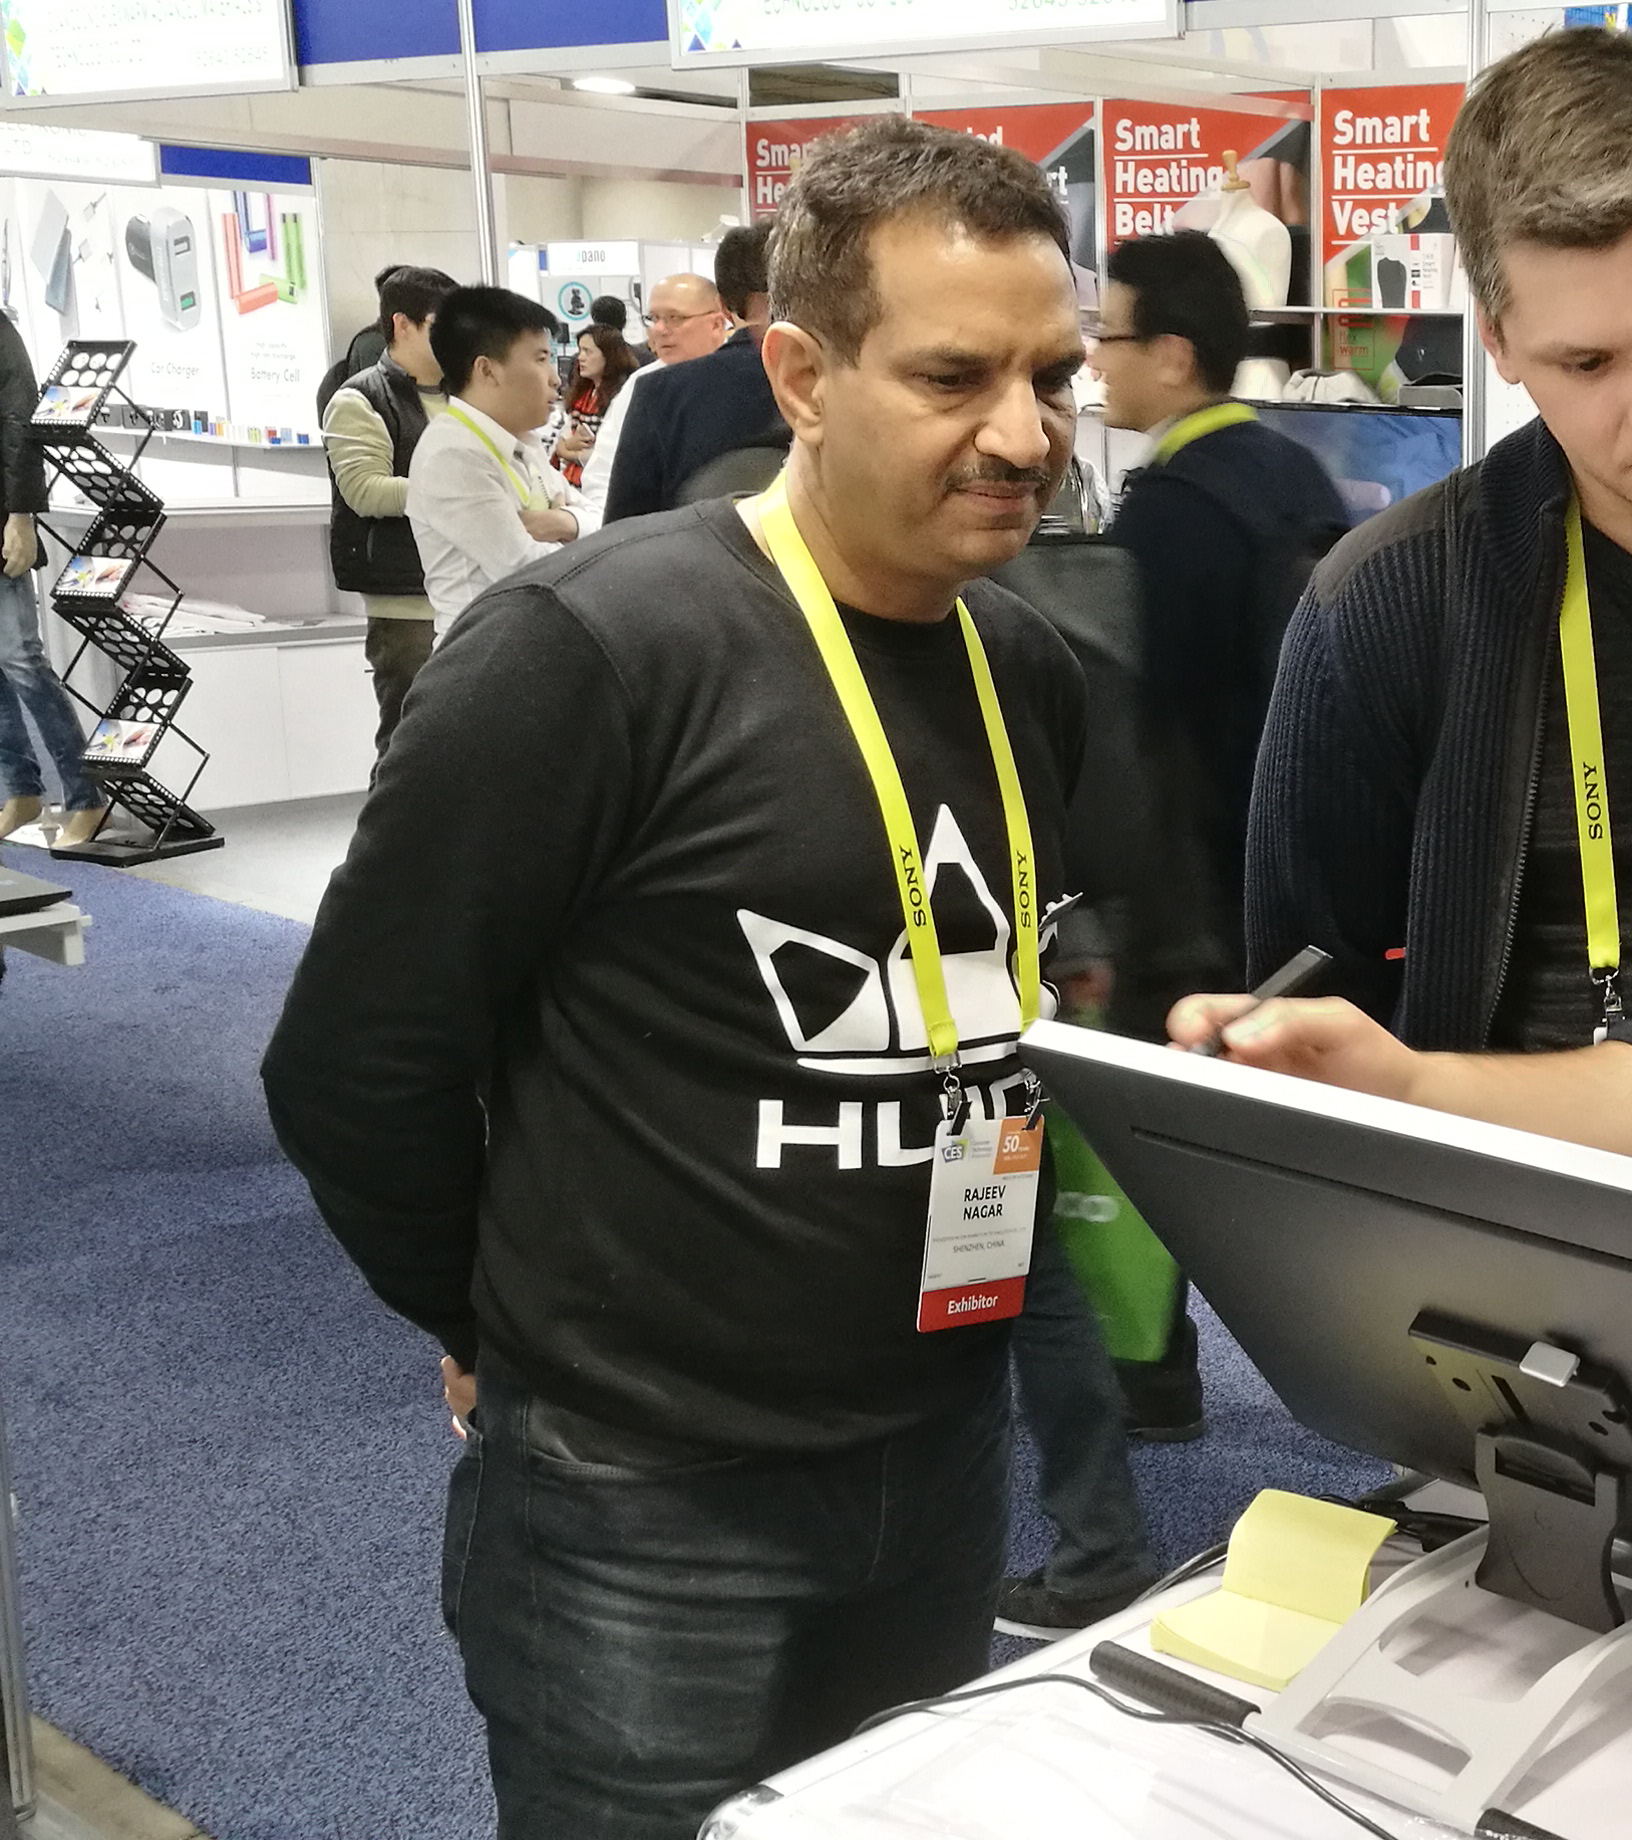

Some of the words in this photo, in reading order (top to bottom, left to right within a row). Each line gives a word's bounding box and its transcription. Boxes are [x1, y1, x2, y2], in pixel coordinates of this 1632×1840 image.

[1114, 117, 1201, 152] Smart
[1332, 108, 1430, 146] Smart
[756, 138, 812, 168] Smar
[1114, 158, 1224, 195] Heating
[1332, 153, 1445, 191] Heatin
[1114, 203, 1175, 237] Belt
[1332, 200, 1399, 236] Vest
[151, 361, 164, 375] Car
[166, 361, 201, 379] Charger
[250, 366, 280, 385] Battery
[283, 368, 301, 384] Cell
[1582, 761, 1603, 840] SONY
[899, 844, 927, 928] SONY
[1016, 850, 1032, 928] SONY
[942, 1144, 964, 1161] CES
[1002, 1135, 1020, 1153] 50
[963, 1184, 1007, 1202] RAJEEV
[962, 1203, 1003, 1221] NAGAR
[986, 1239, 1005, 1252] CHINA
[946, 1294, 999, 1316] Exhibitor
